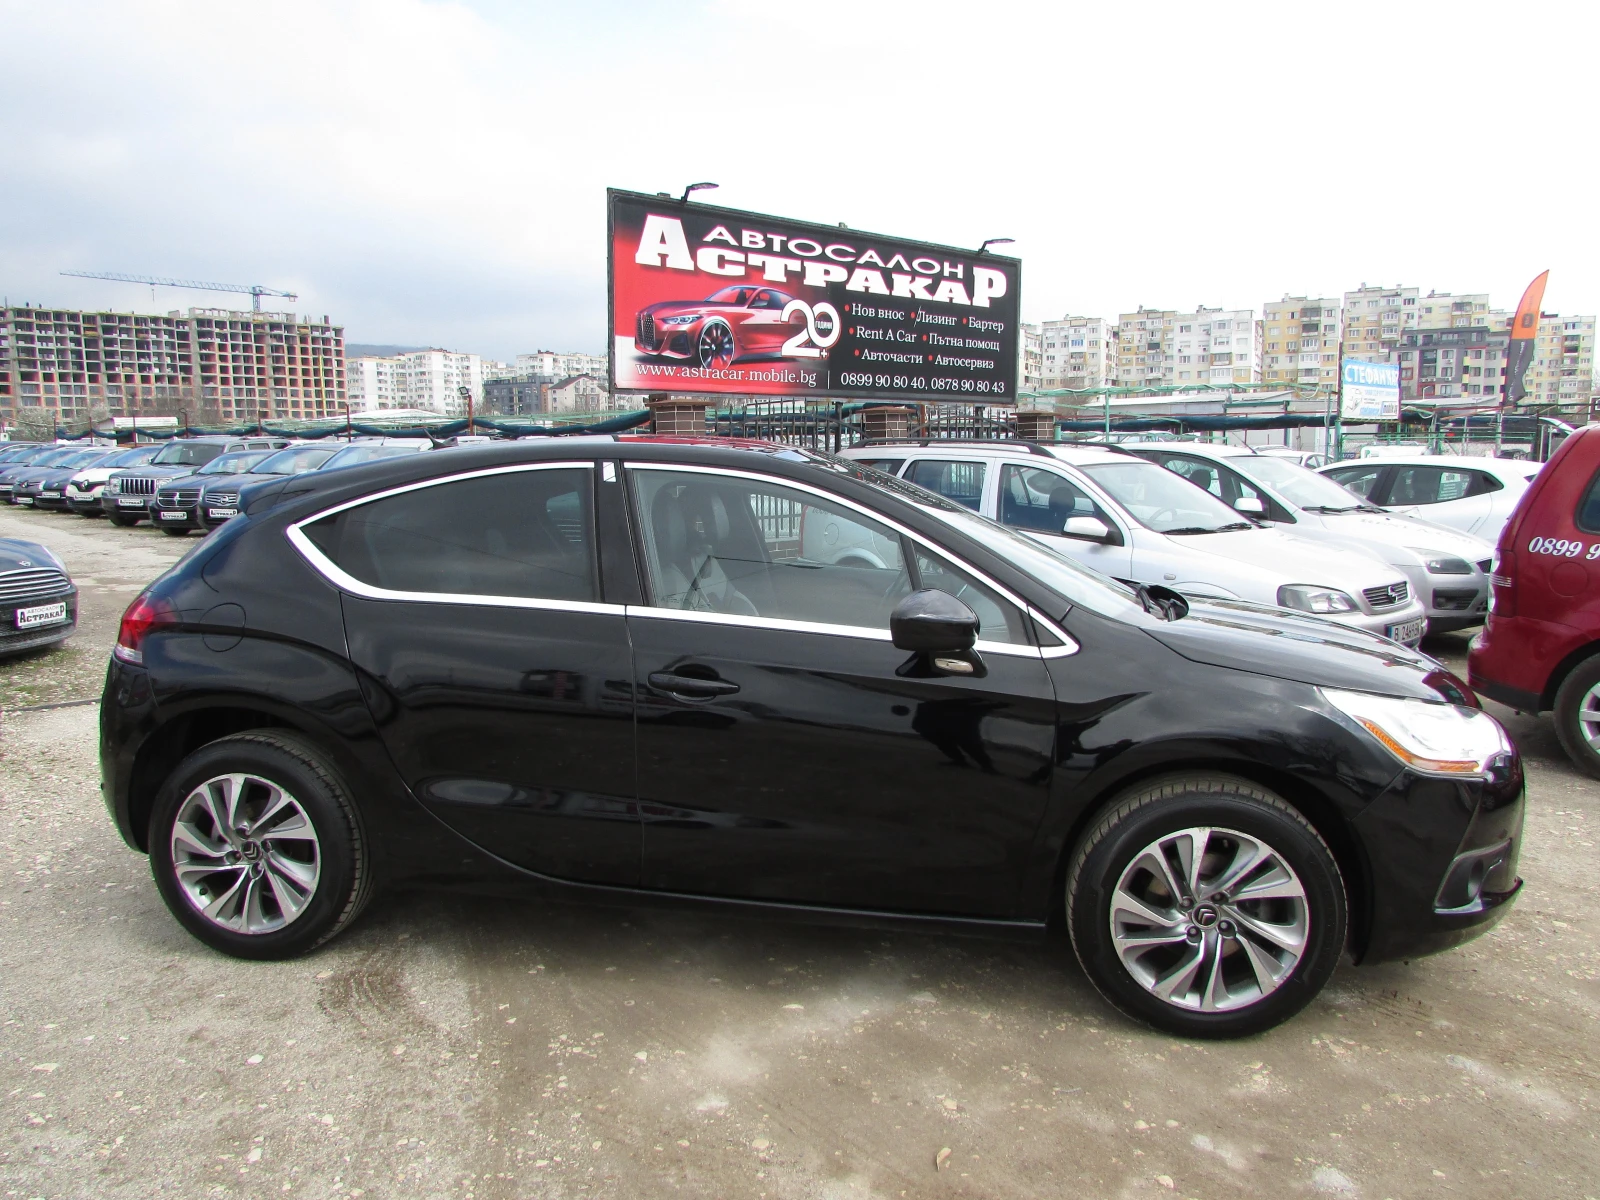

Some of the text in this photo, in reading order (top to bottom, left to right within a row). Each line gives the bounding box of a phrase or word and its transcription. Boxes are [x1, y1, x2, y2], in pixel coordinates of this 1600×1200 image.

[634, 213, 1007, 308] АСТРАКАР
[702, 224, 964, 279] АВТОСАЛОН
[852, 303, 875, 317] Нов
[878, 307, 905, 320] внос
[969, 317, 1004, 334] Бартер
[856, 326, 1000, 352] Rent A Car Пътна помощ
[862, 349, 994, 371] Авточасти Автосервиз
[636, 363, 817, 387] www.astracar.mobile.bg
[841, 373, 873, 387] 0899
[875, 375, 891, 388] 90
[893, 376, 908, 389] 80
[931, 378, 959, 391] 0878
[960, 379, 974, 392] 90
[976, 381, 990, 393] 80
[991, 382, 1005, 394] 43
[1528, 536, 1583, 558] 0899
[19, 604, 65, 624] АСТРАКАР
